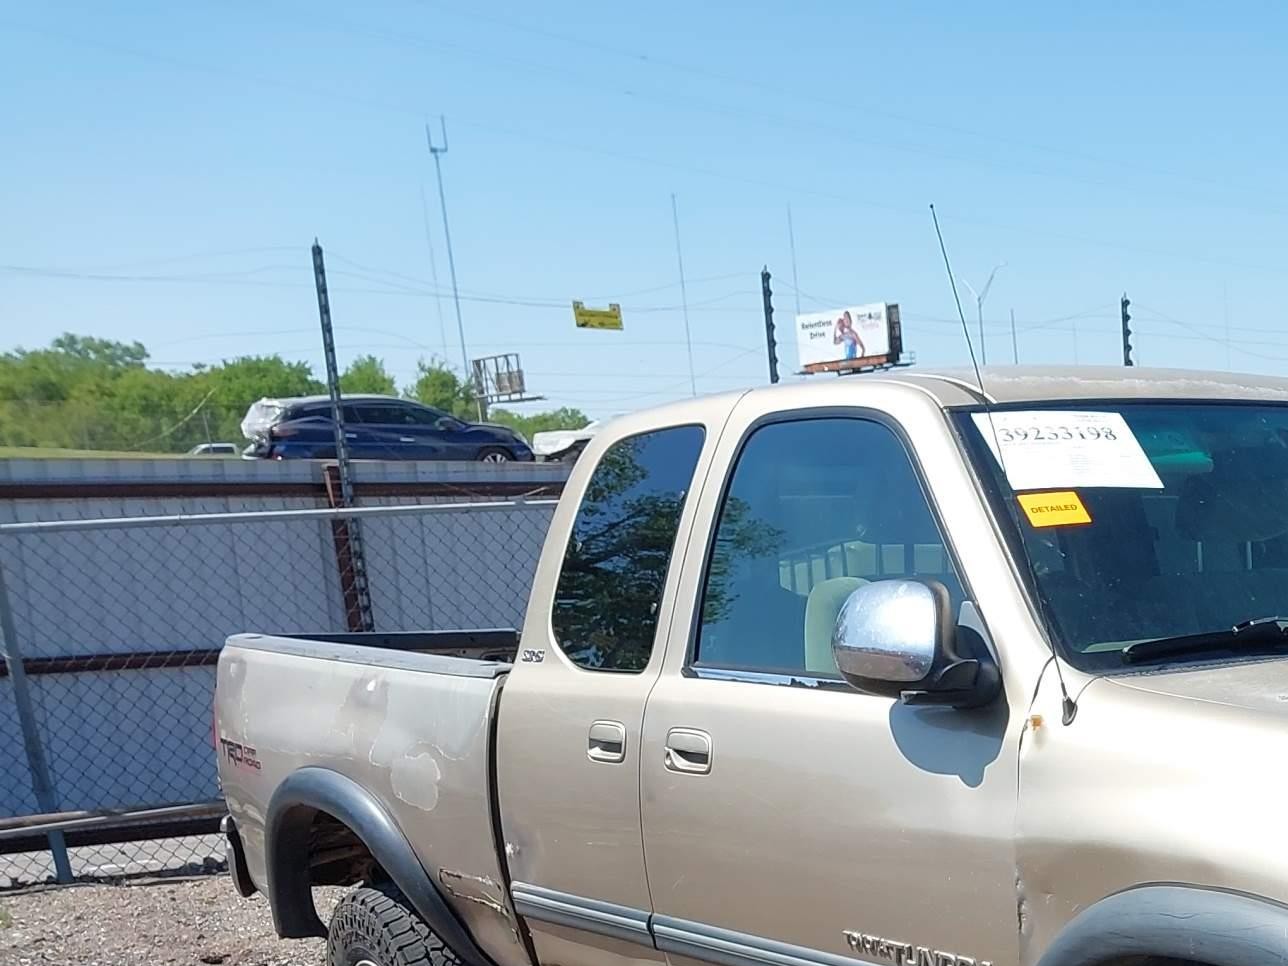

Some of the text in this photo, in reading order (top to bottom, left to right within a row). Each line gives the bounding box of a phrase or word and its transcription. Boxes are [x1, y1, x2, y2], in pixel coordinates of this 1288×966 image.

[999, 426, 1117, 442] 39233198
[1030, 504, 1078, 514] DETAILED
[220, 737, 243, 767] TRD
